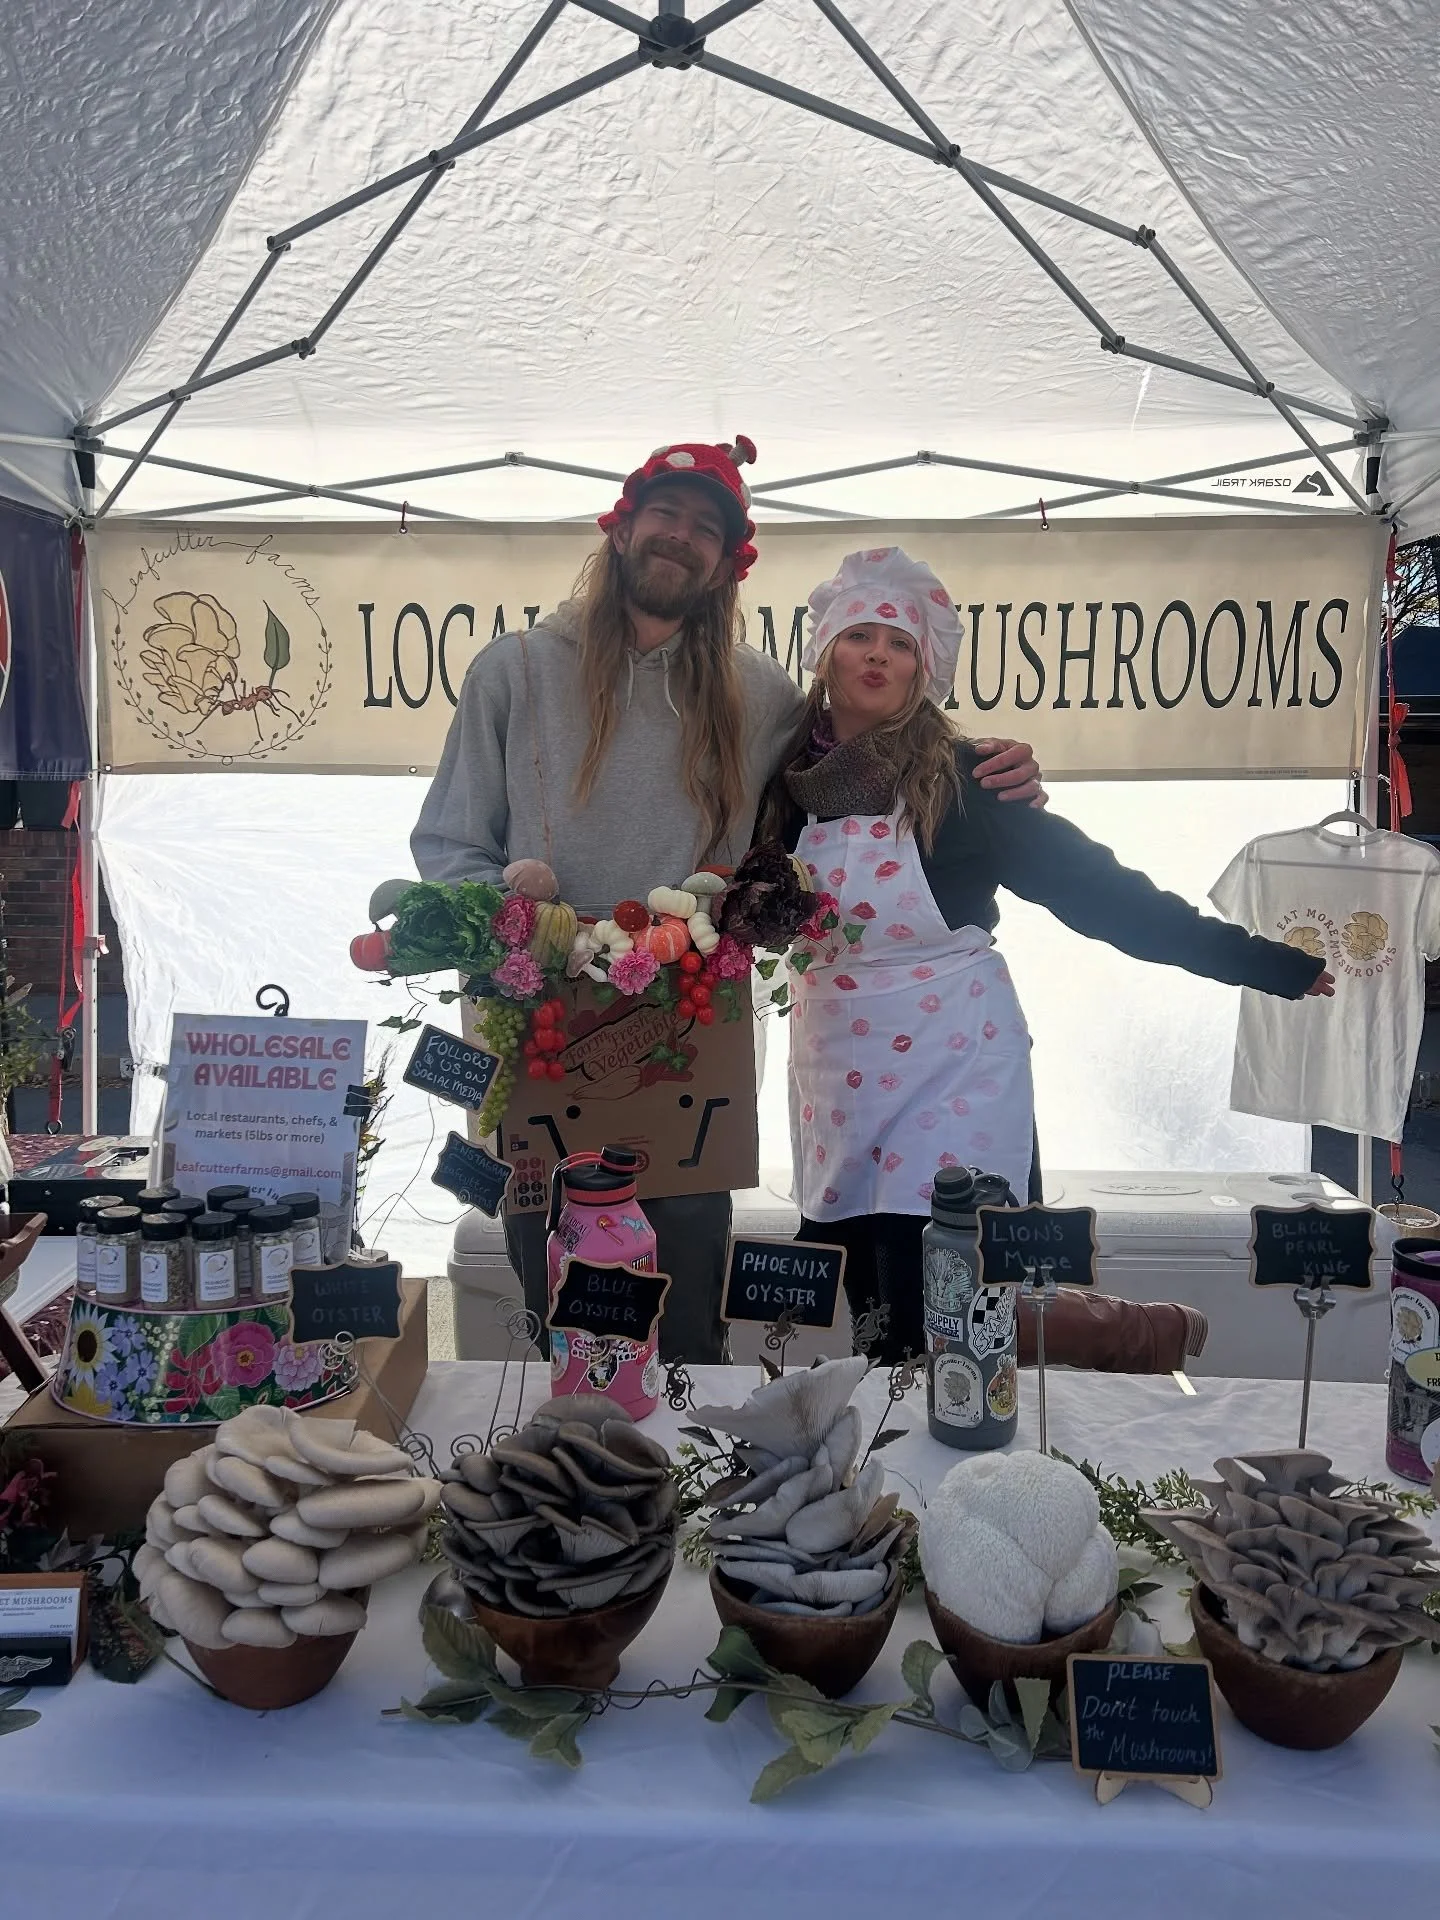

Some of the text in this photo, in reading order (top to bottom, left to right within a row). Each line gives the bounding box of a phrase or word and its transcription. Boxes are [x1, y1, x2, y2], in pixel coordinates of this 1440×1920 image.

[358, 602, 541, 709] LOC
[1276, 907, 1398, 979] EAT MORE MUSHROOMS
[185, 1031, 352, 1061] WHOLESALE
[194, 1063, 337, 1091] AVAILABLE
[440, 1058, 462, 1075] US
[412, 1060, 483, 1102] SOCIAL MEDIA
[186, 1111, 338, 1128] Local restaurants, chefs, &
[195, 1127, 326, 1144] markets (5lbs or more)
[176, 1161, 342, 1179] Leafcutterfarms@gmail.com
[1272, 1219, 1333, 1239] BLACK
[1284, 1239, 1342, 1256] PEARL
[742, 1251, 831, 1279] PHOENIX
[1303, 1259, 1351, 1274] KING
[587, 1274, 641, 1299] BLUE
[746, 1283, 817, 1307] OYSTER
[311, 1305, 386, 1325] OYSTER
[1106, 1662, 1176, 1692] PLEASE
[1151, 1700, 1201, 1723] touch
